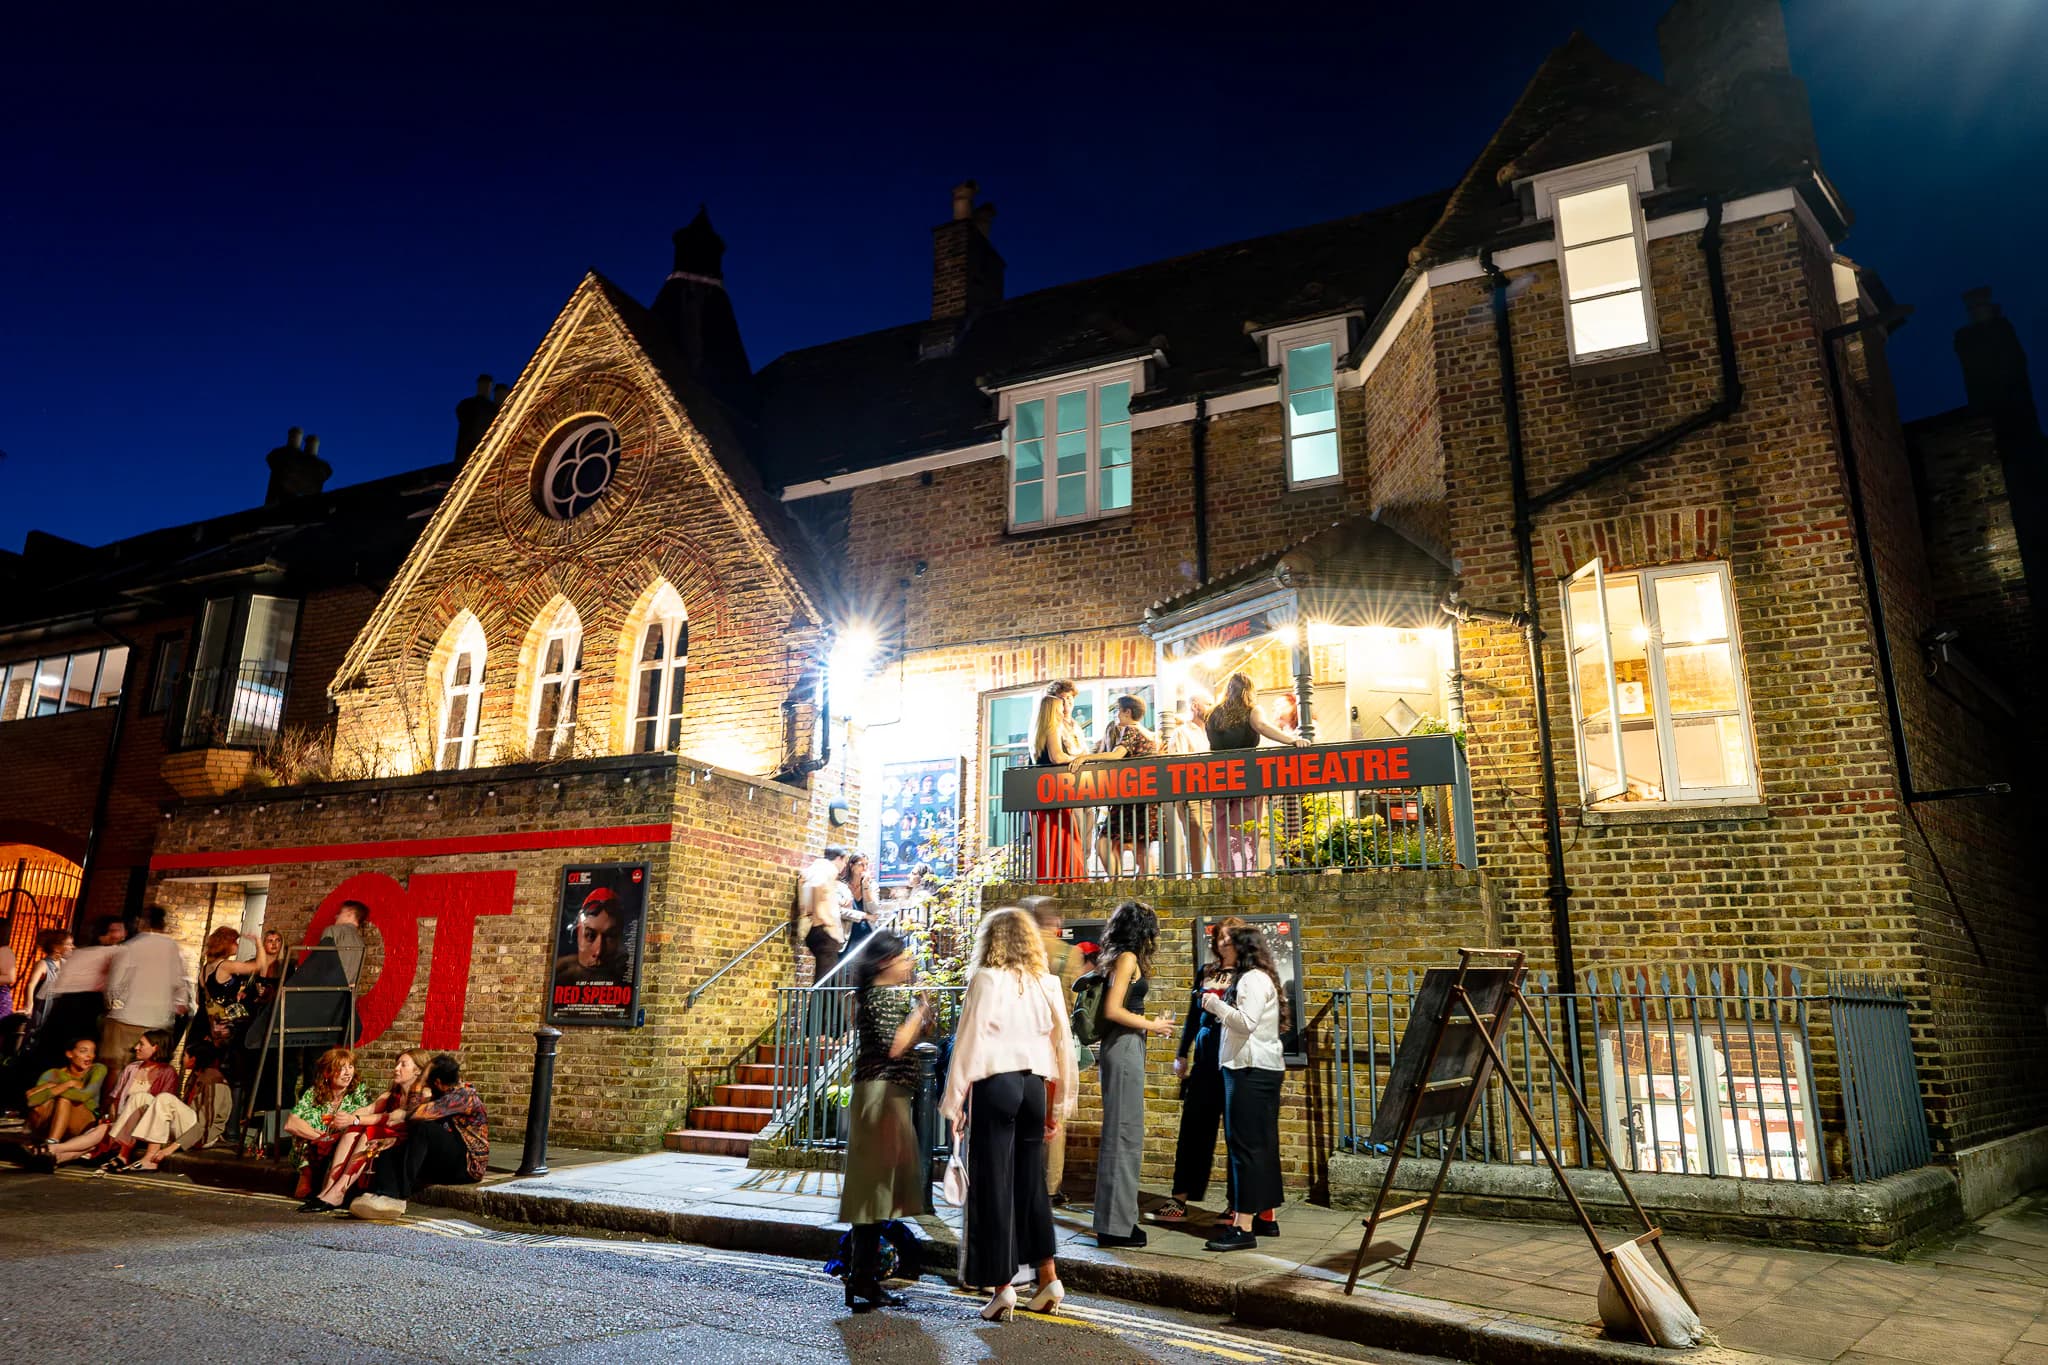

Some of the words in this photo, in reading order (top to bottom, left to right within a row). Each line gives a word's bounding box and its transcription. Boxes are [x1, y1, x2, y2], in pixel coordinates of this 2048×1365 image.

[1037, 766, 1158, 803] ORANGE
[1167, 758, 1247, 794] TREE
[1256, 747, 1410, 789] THEATRE
[297, 869, 518, 1050] OT
[554, 985, 580, 1004] RED
[581, 986, 631, 1005] SPEEDO
